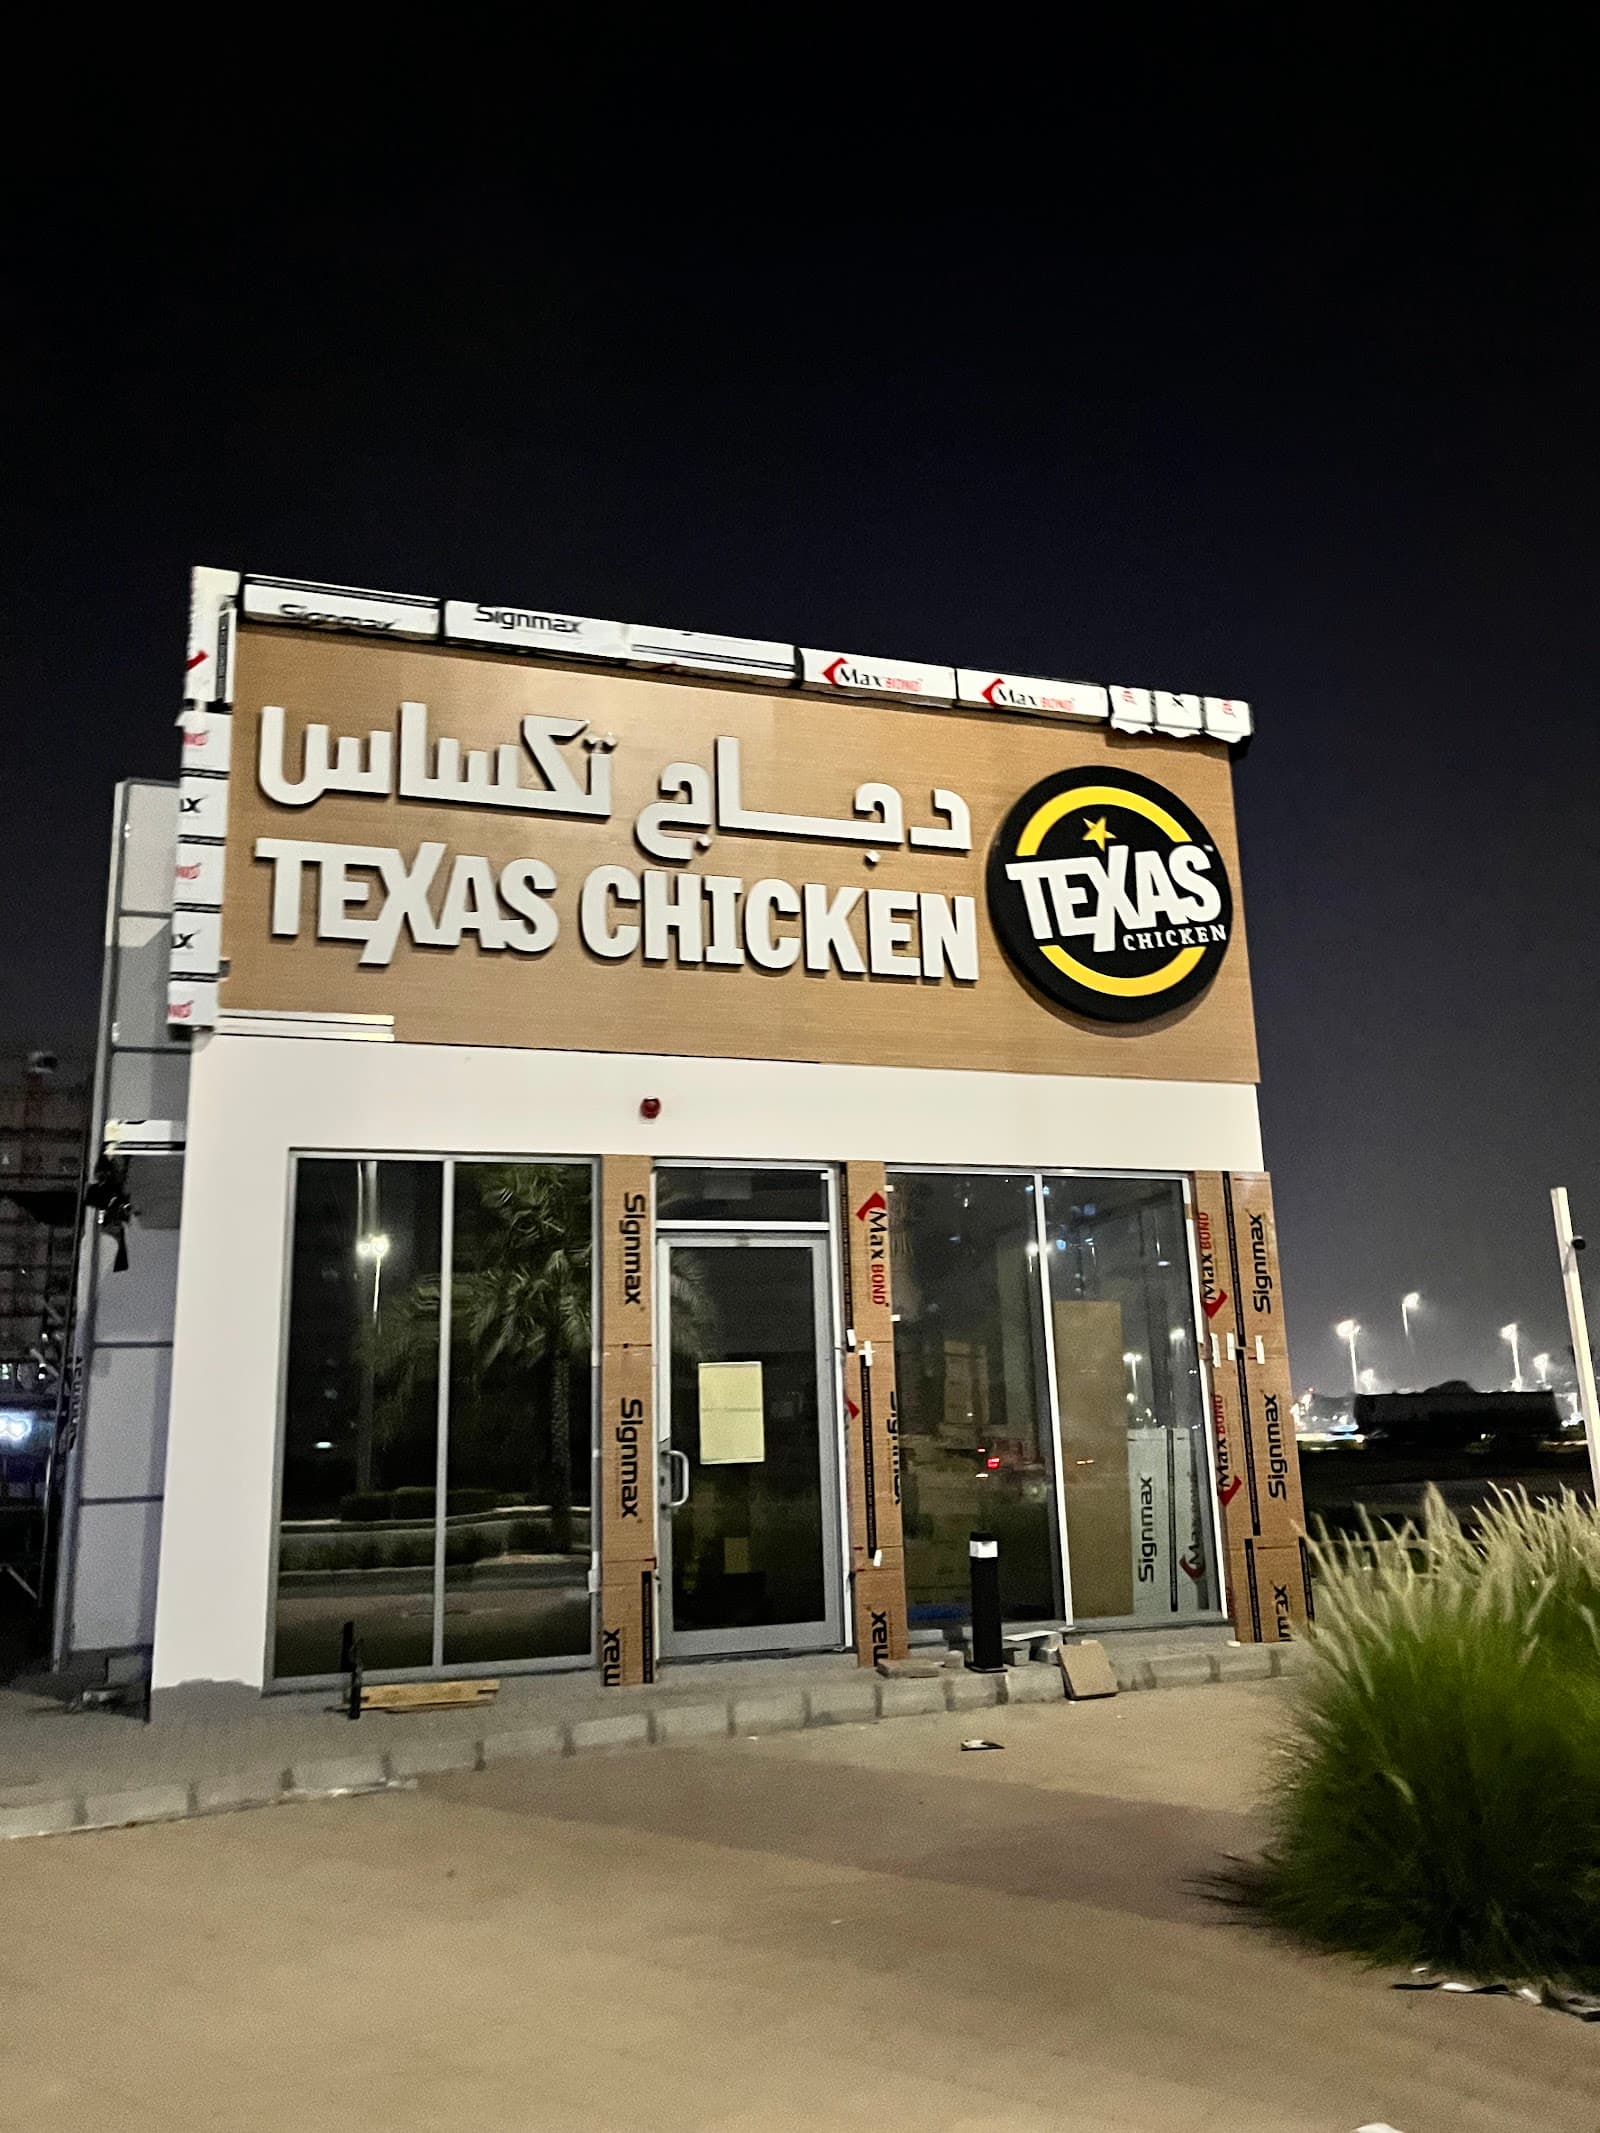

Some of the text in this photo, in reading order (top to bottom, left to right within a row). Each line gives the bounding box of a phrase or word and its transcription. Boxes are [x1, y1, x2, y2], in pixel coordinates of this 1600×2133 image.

[474, 604, 582, 634] Signmax
[259, 702, 618, 817] تكساس
[255, 837, 979, 981] TEXAS CHICKEN
[1005, 844, 1222, 952] TEXAS
[1122, 924, 1227, 951] CHICKEN
[619, 1191, 646, 1305] Signmax
[868, 1210, 888, 1305] Max BOND
[1201, 1253, 1216, 1301] Max
[1249, 1212, 1273, 1315] Signmax
[616, 1397, 644, 1519] Signmax
[1264, 1393, 1288, 1501] Signmax
[1137, 1476, 1158, 1584] Signmax
[603, 1627, 621, 1687] max
